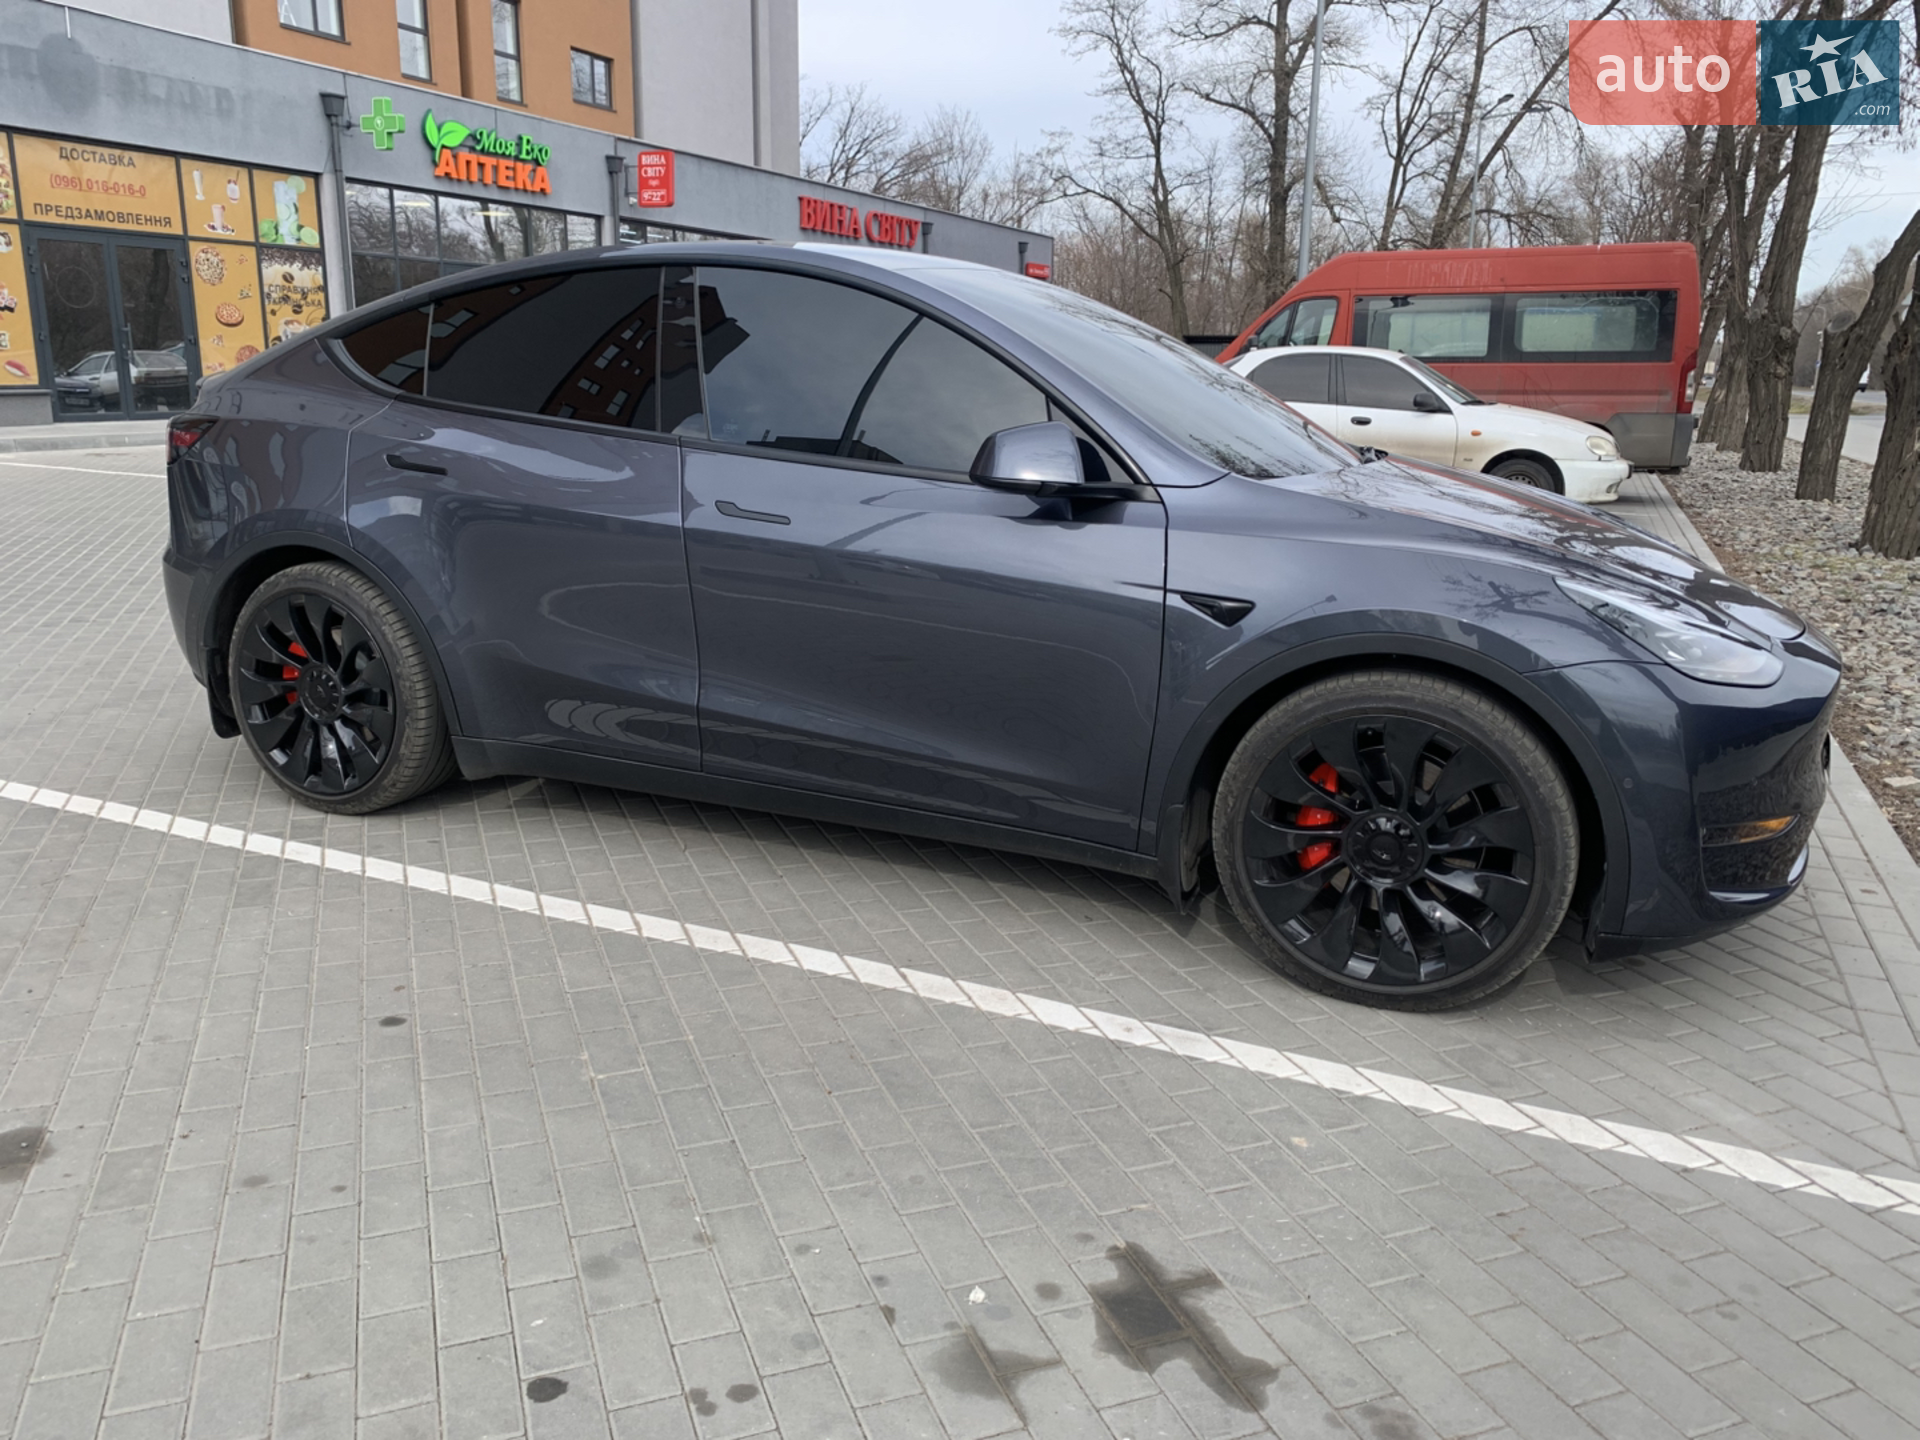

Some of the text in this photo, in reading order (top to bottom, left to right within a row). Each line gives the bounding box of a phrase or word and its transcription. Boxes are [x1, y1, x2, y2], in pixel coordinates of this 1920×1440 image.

[58, 146, 136, 168] ДОСТАВКА
[474, 128, 551, 166] Моя Еко
[641, 154, 666, 165] ВИНА
[434, 148, 553, 194] АПТЕКА
[641, 166, 667, 177] СВІТУ
[50, 173, 146, 197] (096) 016-016-0
[33, 202, 172, 228] ПРЕДЗАМОВЛЕННЯ
[798, 196, 922, 248] ВИНА СВІТУ
